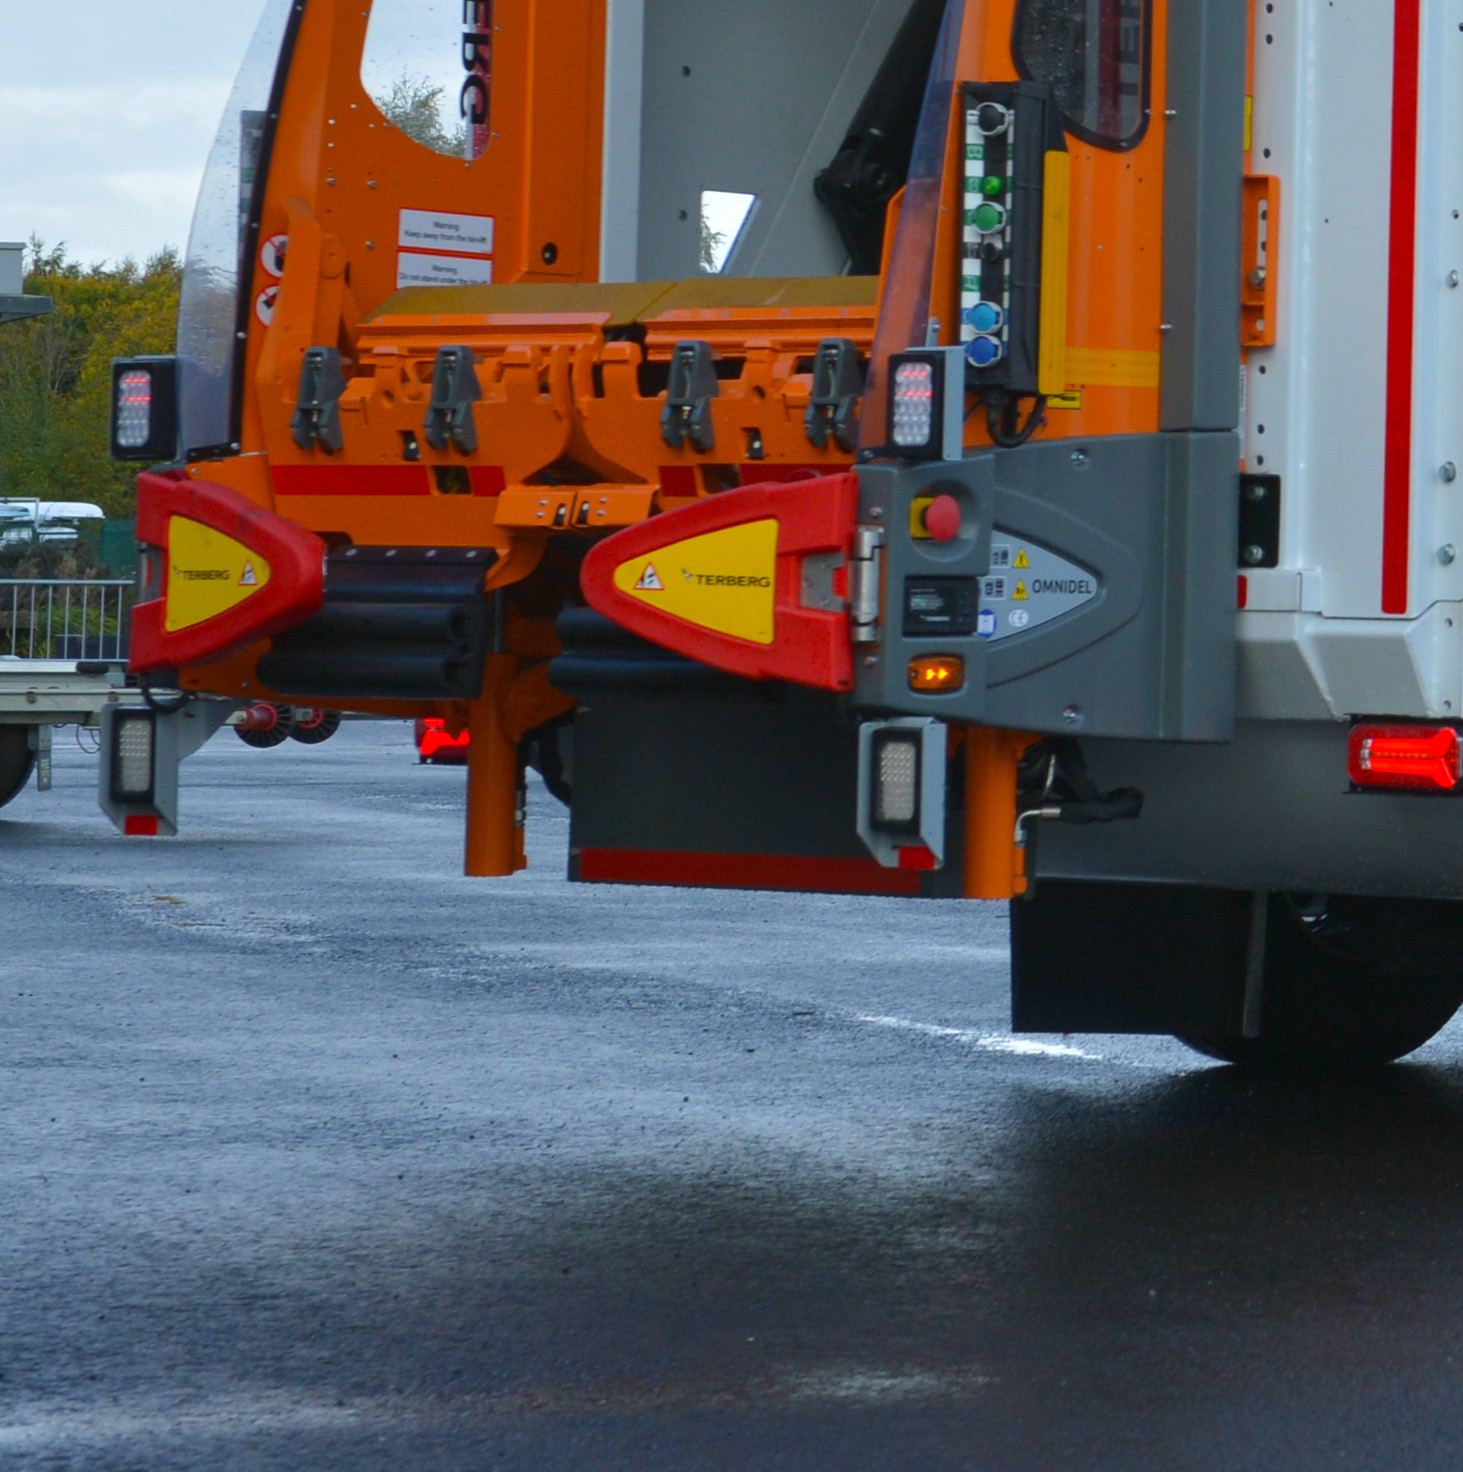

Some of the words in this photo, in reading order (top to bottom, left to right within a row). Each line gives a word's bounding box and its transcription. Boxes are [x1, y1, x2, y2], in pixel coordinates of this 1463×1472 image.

[183, 569, 230, 581] TERBERG
[695, 574, 771, 588] TERBERG
[1032, 579, 1093, 595] OMNIDEL
